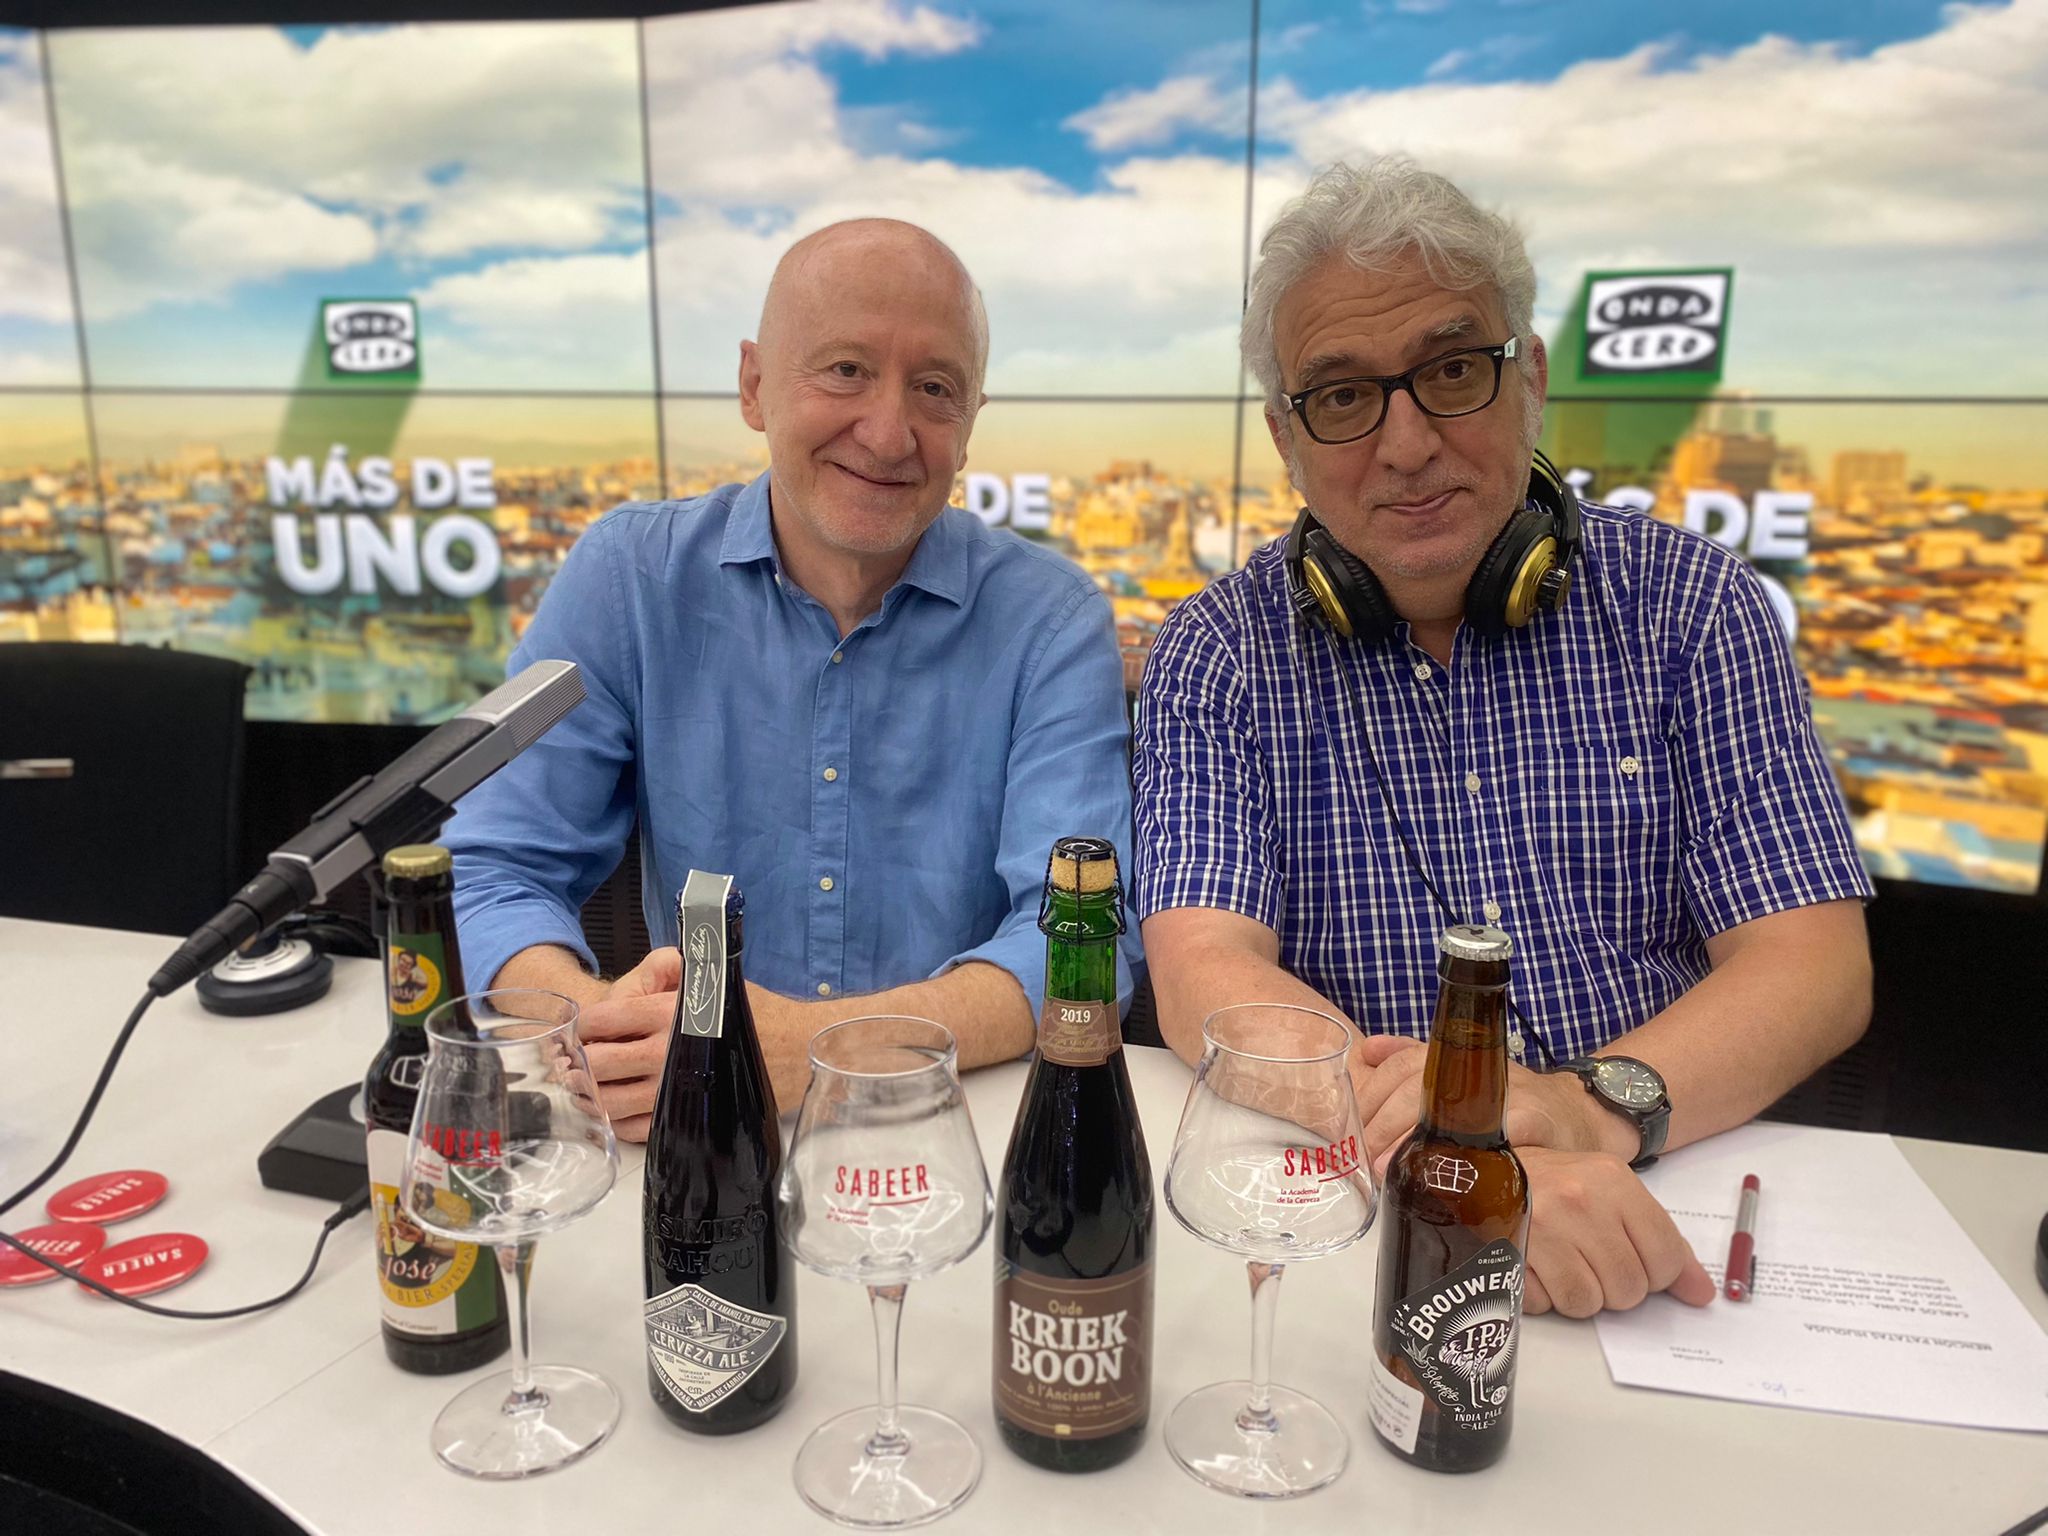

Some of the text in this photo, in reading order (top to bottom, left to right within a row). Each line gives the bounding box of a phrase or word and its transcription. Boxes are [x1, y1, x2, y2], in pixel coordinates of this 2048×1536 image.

[1603, 296, 1704, 321] ONDA
[1608, 335, 1699, 357] CERO
[265, 443, 497, 508] MÁS DE
[966, 474, 1050, 528] DE
[1683, 489, 1813, 559] DE
[271, 513, 500, 598] UNO
[1060, 1007, 1091, 1024] 2019
[1284, 1136, 1358, 1176] SABEER
[80, 1178, 142, 1211] SABEER
[835, 1164, 928, 1197] SABEER
[103, 1247, 183, 1277] SABEER
[1490, 1248, 1505, 1256] HET
[397, 1288, 434, 1303] BIER
[1048, 1299, 1084, 1315] Oude
[1009, 1300, 1128, 1351] KRIEK
[653, 1329, 714, 1367] CERVEZA
[718, 1350, 750, 1369] ALE
[1011, 1336, 1124, 1387] BOON
[1037, 1383, 1102, 1402] l'Ancienne
[1454, 1407, 1503, 1422] INDIA PALE
[1471, 1421, 1488, 1431] ALE
